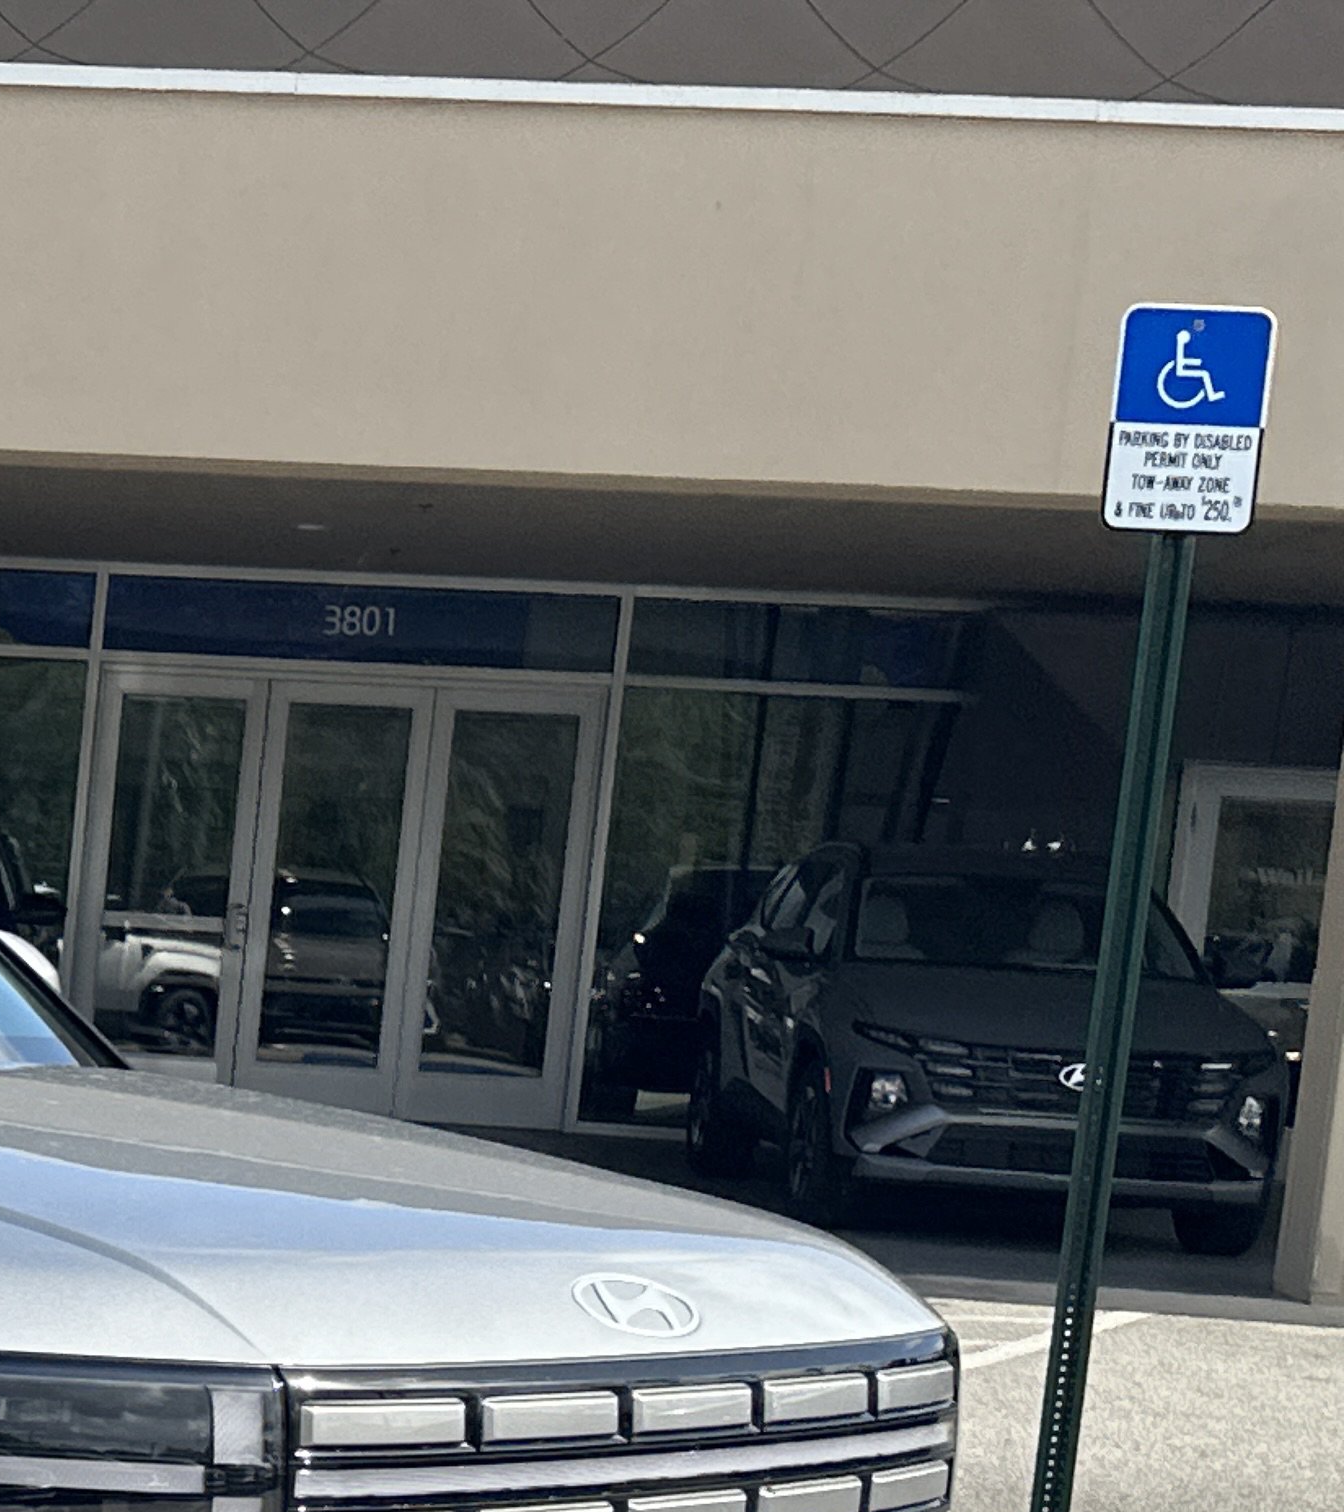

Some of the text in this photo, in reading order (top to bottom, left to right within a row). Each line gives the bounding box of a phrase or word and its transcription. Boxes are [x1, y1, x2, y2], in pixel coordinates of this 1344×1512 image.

[1119, 430, 1253, 451] PARKING BY DISABLED
[1143, 451, 1223, 471] PERMIT ONLY
[1131, 473, 1230, 493] TOW-AWAY ZONE
[1114, 500, 1123, 517] &
[1128, 502, 1155, 519] FINE
[322, 604, 396, 637] 3801
